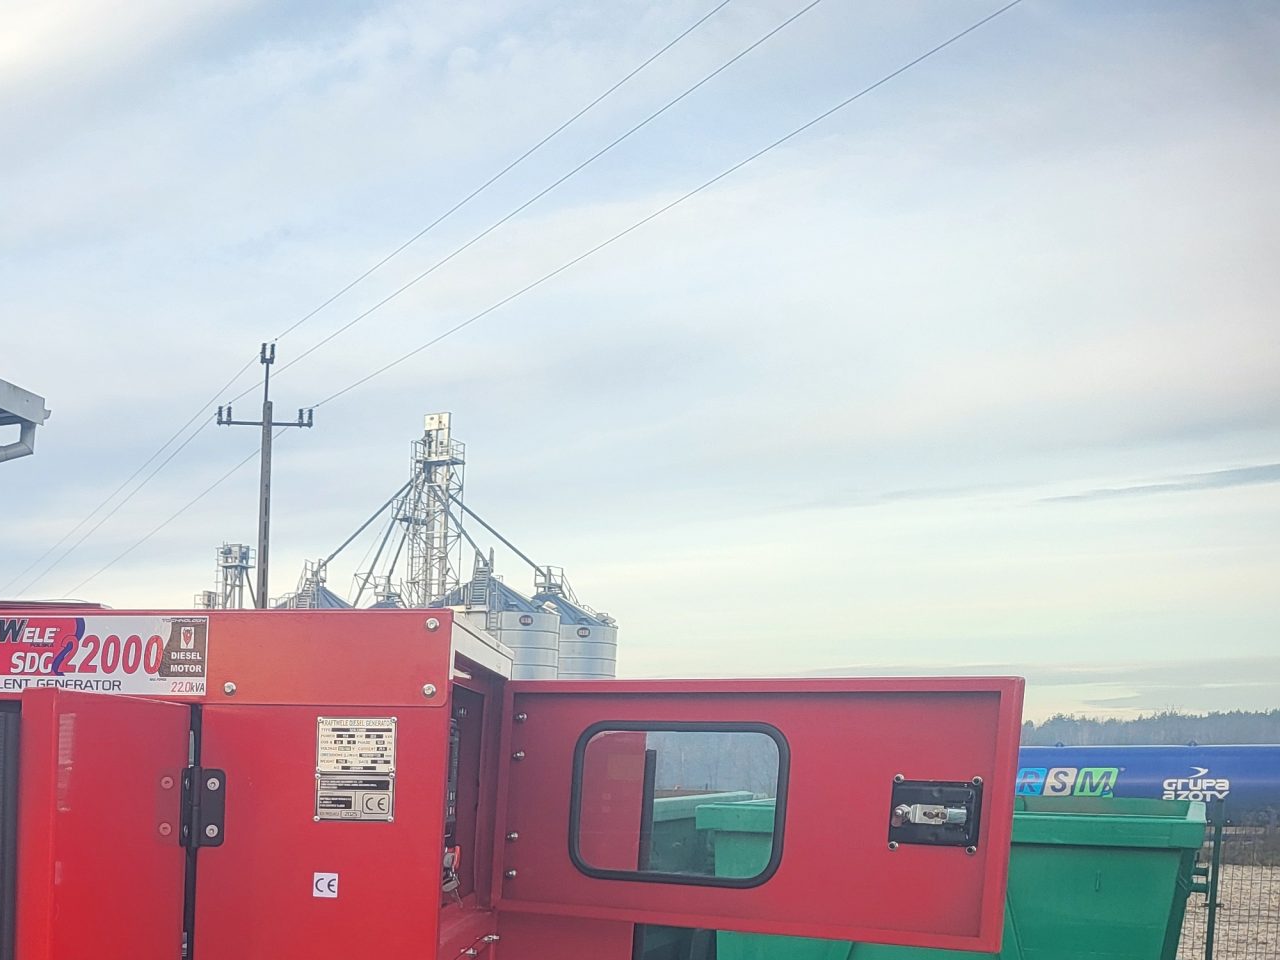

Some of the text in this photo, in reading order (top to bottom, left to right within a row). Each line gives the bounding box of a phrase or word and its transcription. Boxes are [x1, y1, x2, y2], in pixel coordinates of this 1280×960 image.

[171, 651, 202, 660] DIESEL
[170, 665, 202, 673] MOTOR
[36, 679, 122, 691] GENERATOR
[1018, 769, 1113, 795] RSM
[365, 797, 386, 811] CE
[315, 878, 337, 894] CE
